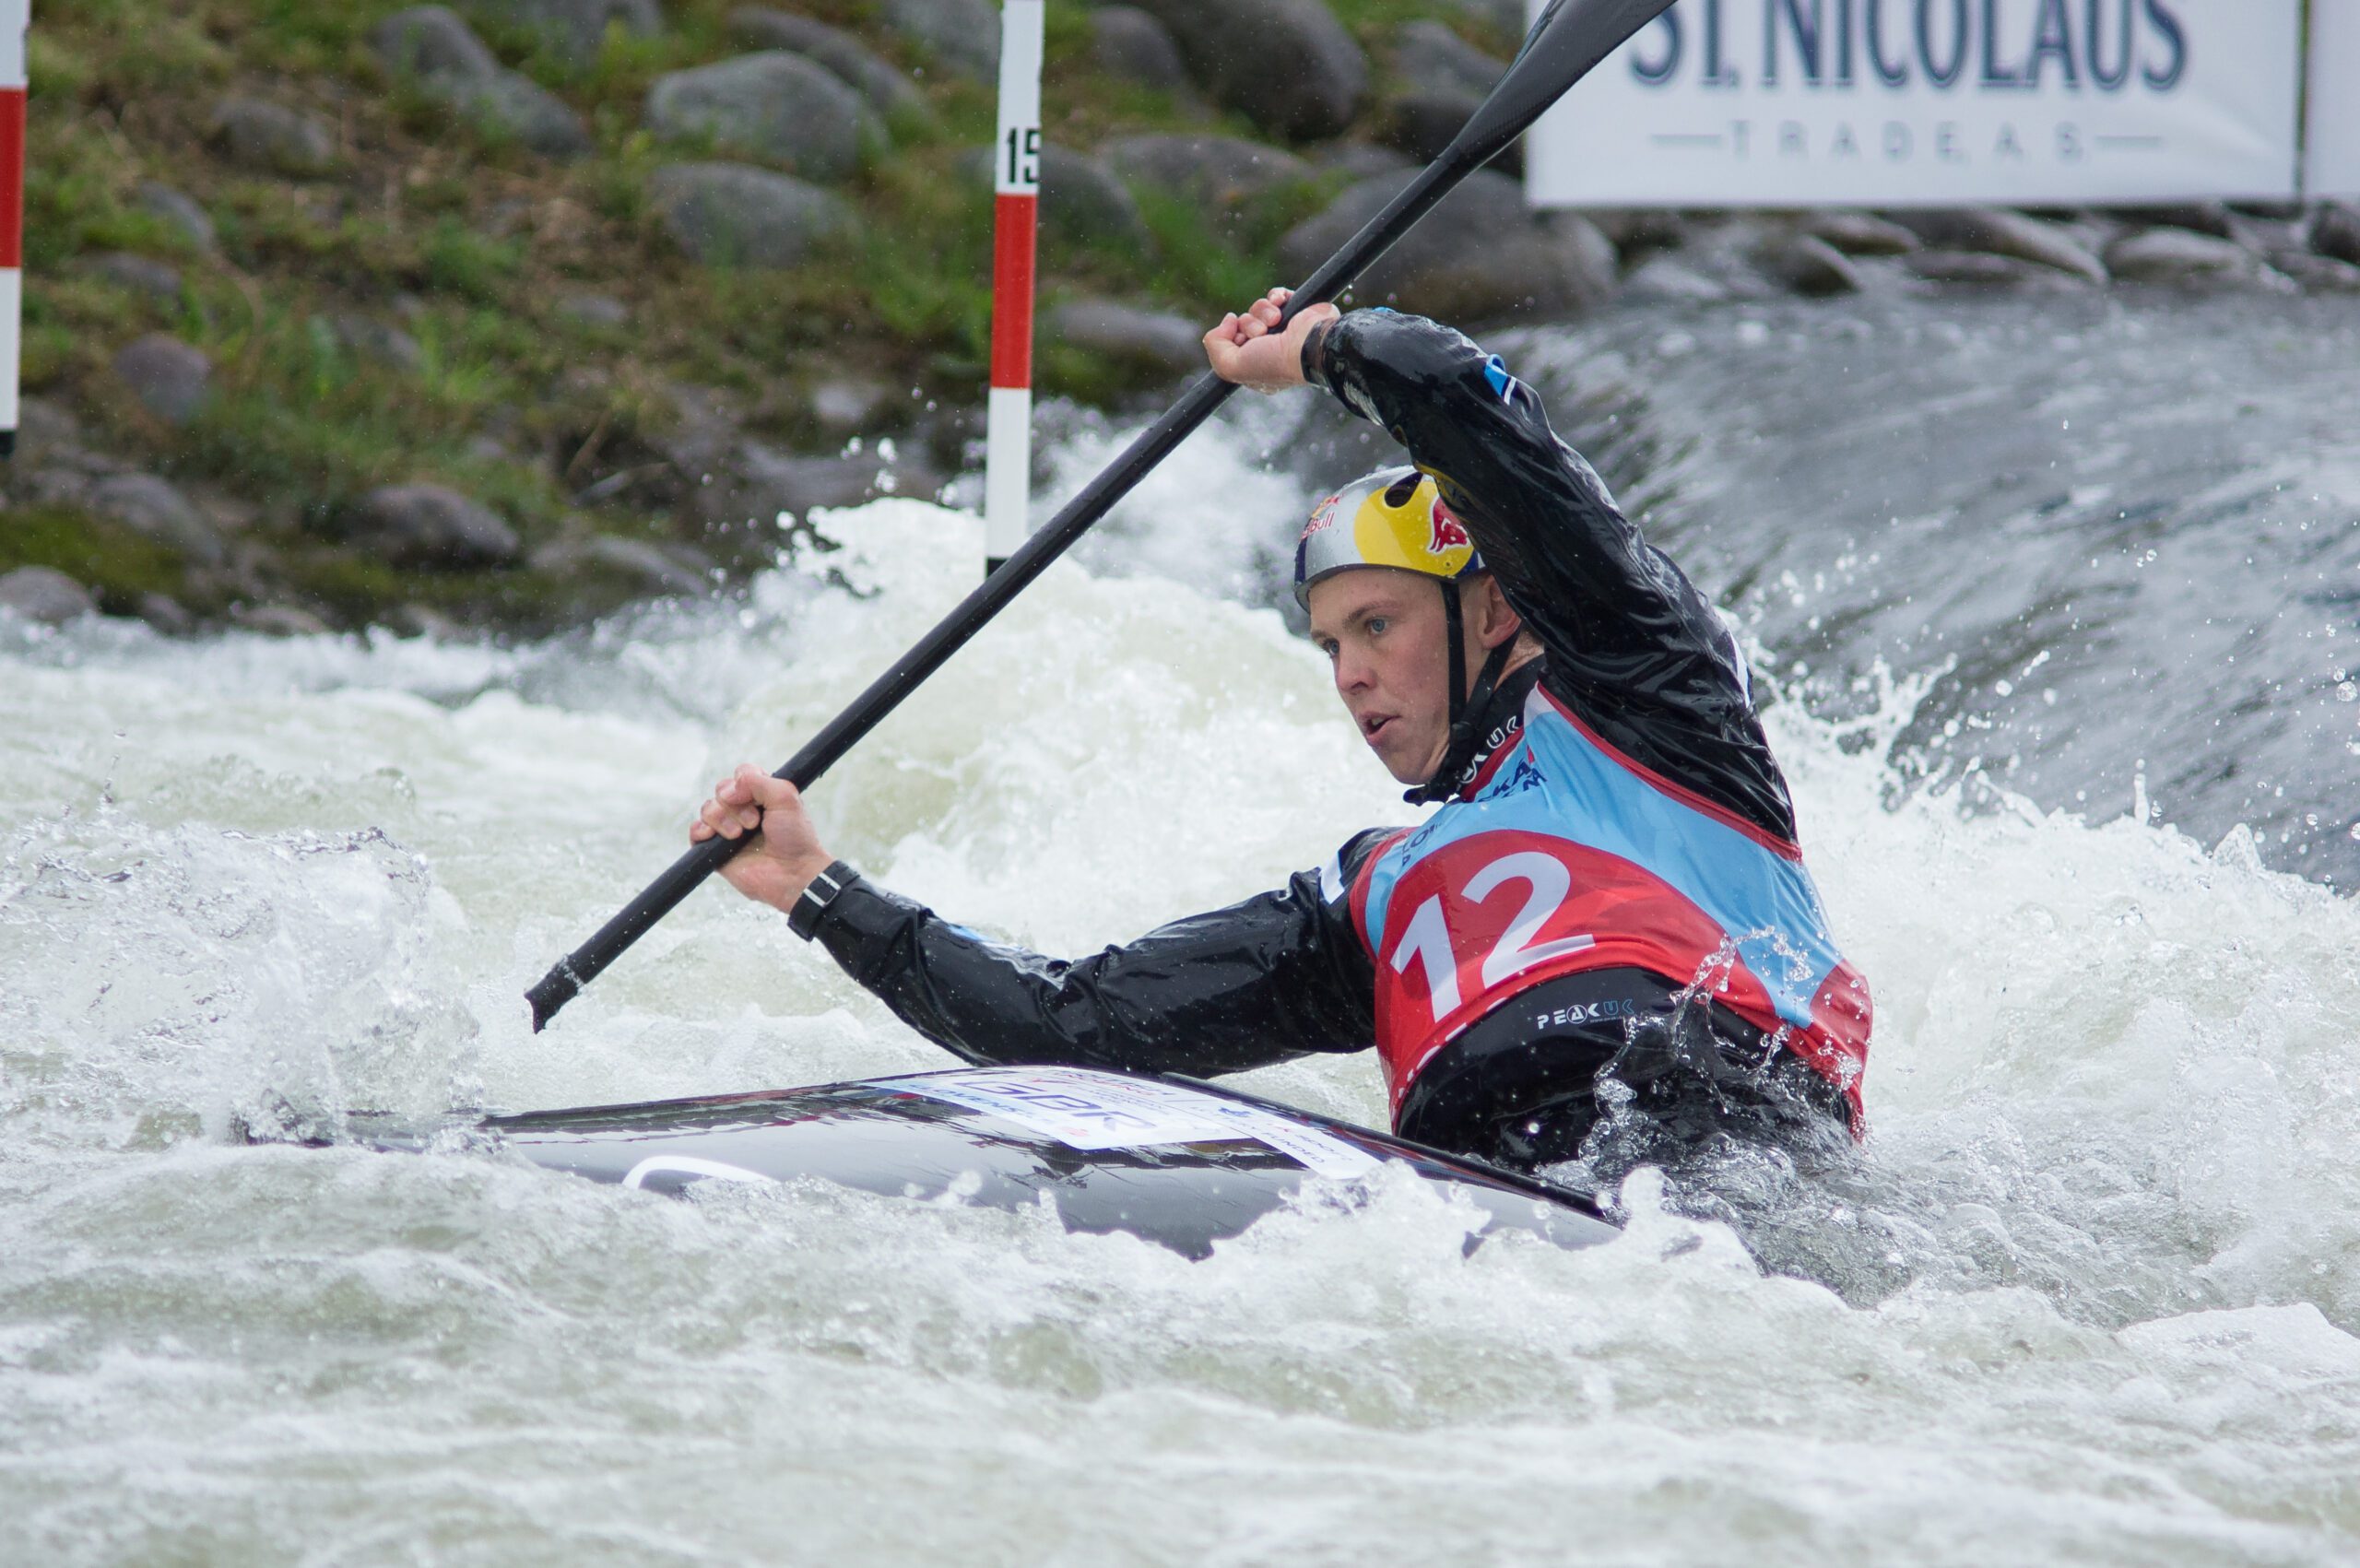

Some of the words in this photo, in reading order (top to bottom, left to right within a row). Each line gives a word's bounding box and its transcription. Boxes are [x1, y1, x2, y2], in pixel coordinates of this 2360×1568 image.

[1390, 851, 1596, 1023] 12
[1537, 1003, 1600, 1030] PEAK
[1603, 998, 1634, 1016] UK
